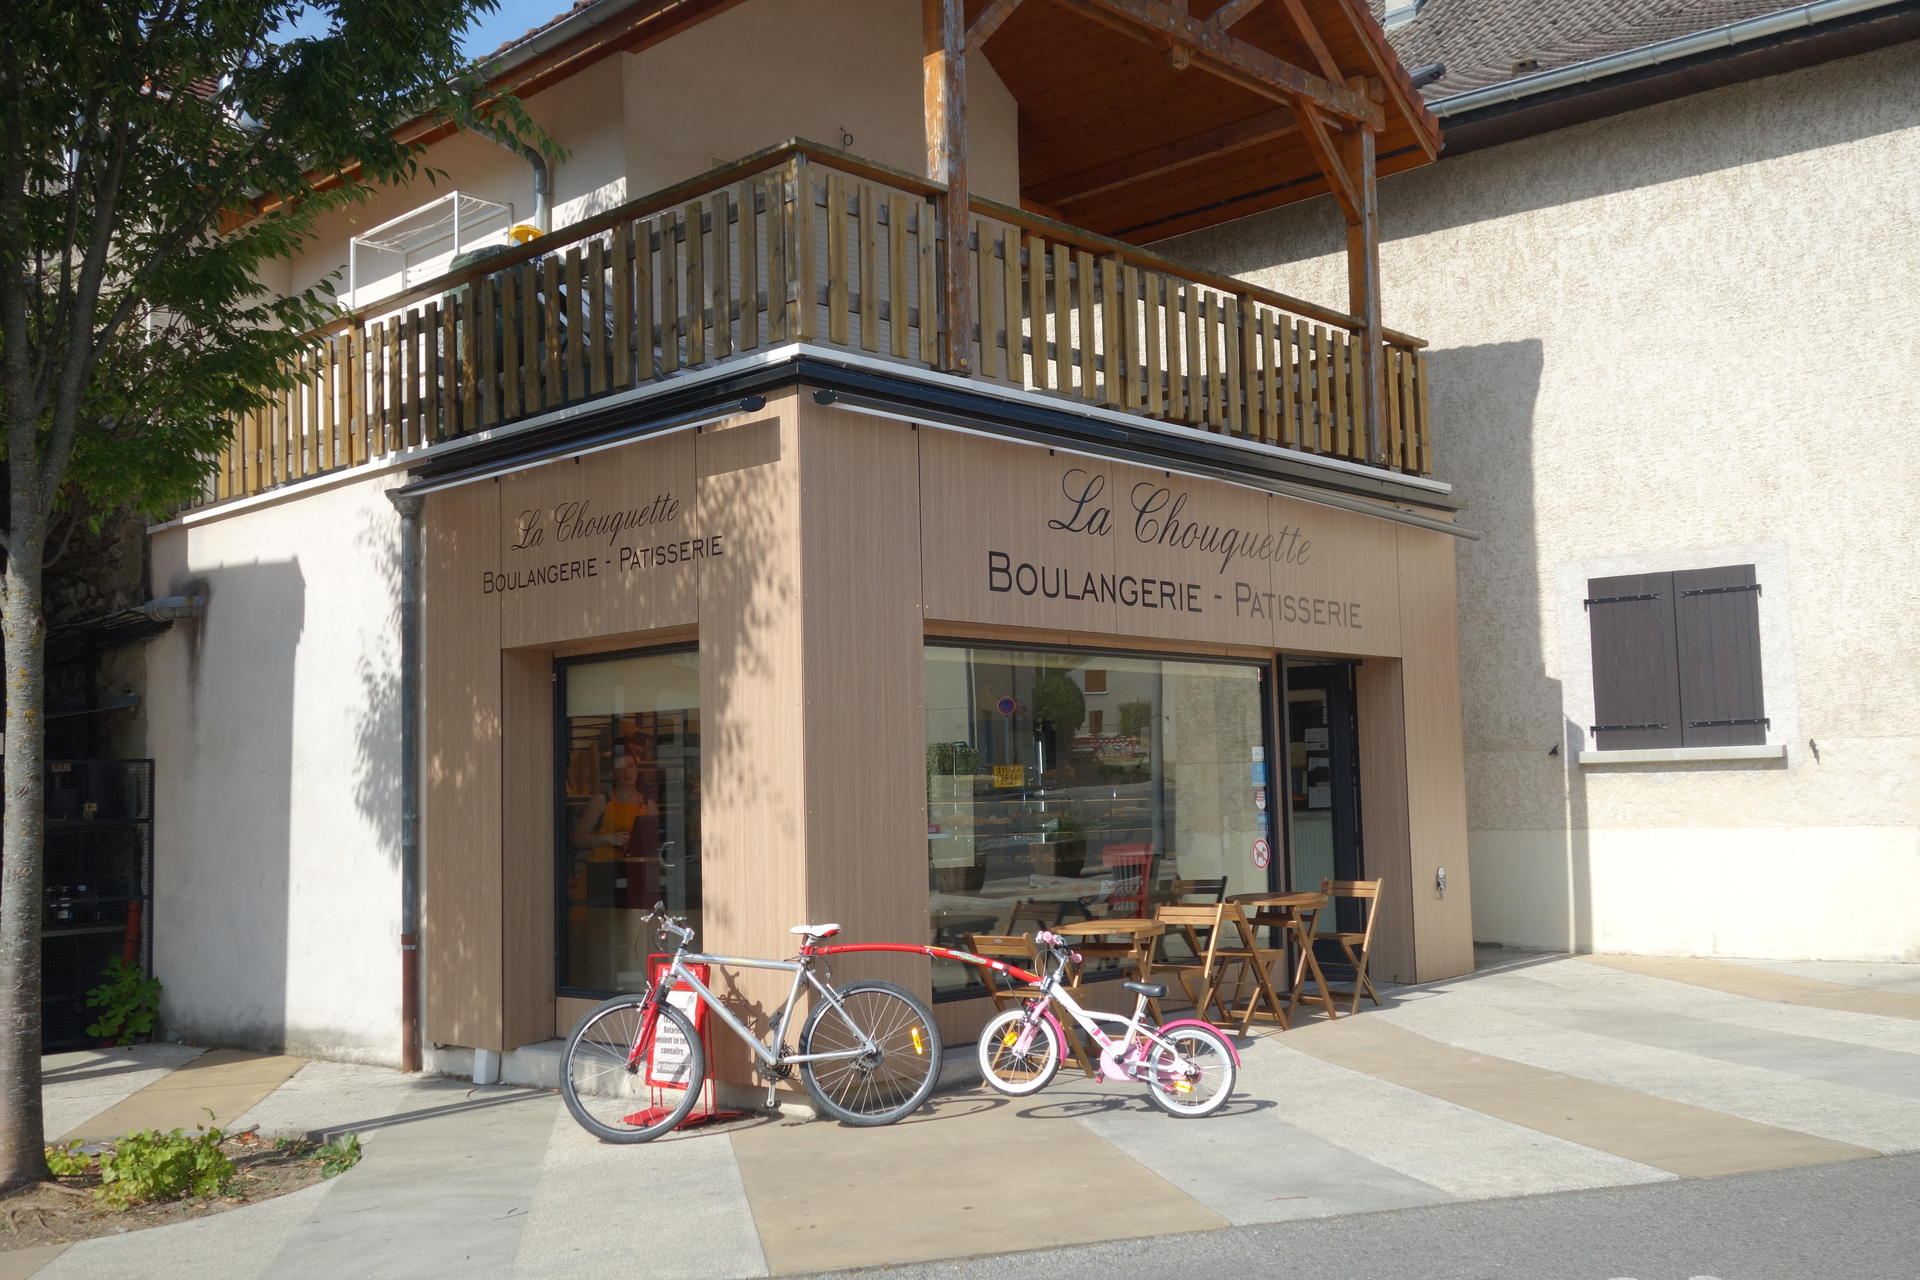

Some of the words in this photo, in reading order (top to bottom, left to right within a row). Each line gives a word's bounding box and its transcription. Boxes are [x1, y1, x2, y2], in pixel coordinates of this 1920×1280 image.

[511, 508, 545, 551] La
[553, 493, 680, 546] Chouquette
[1047, 468, 1112, 537] La
[1130, 482, 1312, 575] Chouquette
[483, 557, 598, 594] BOULANGERIE
[988, 550, 1203, 613] BOULANGERIE
